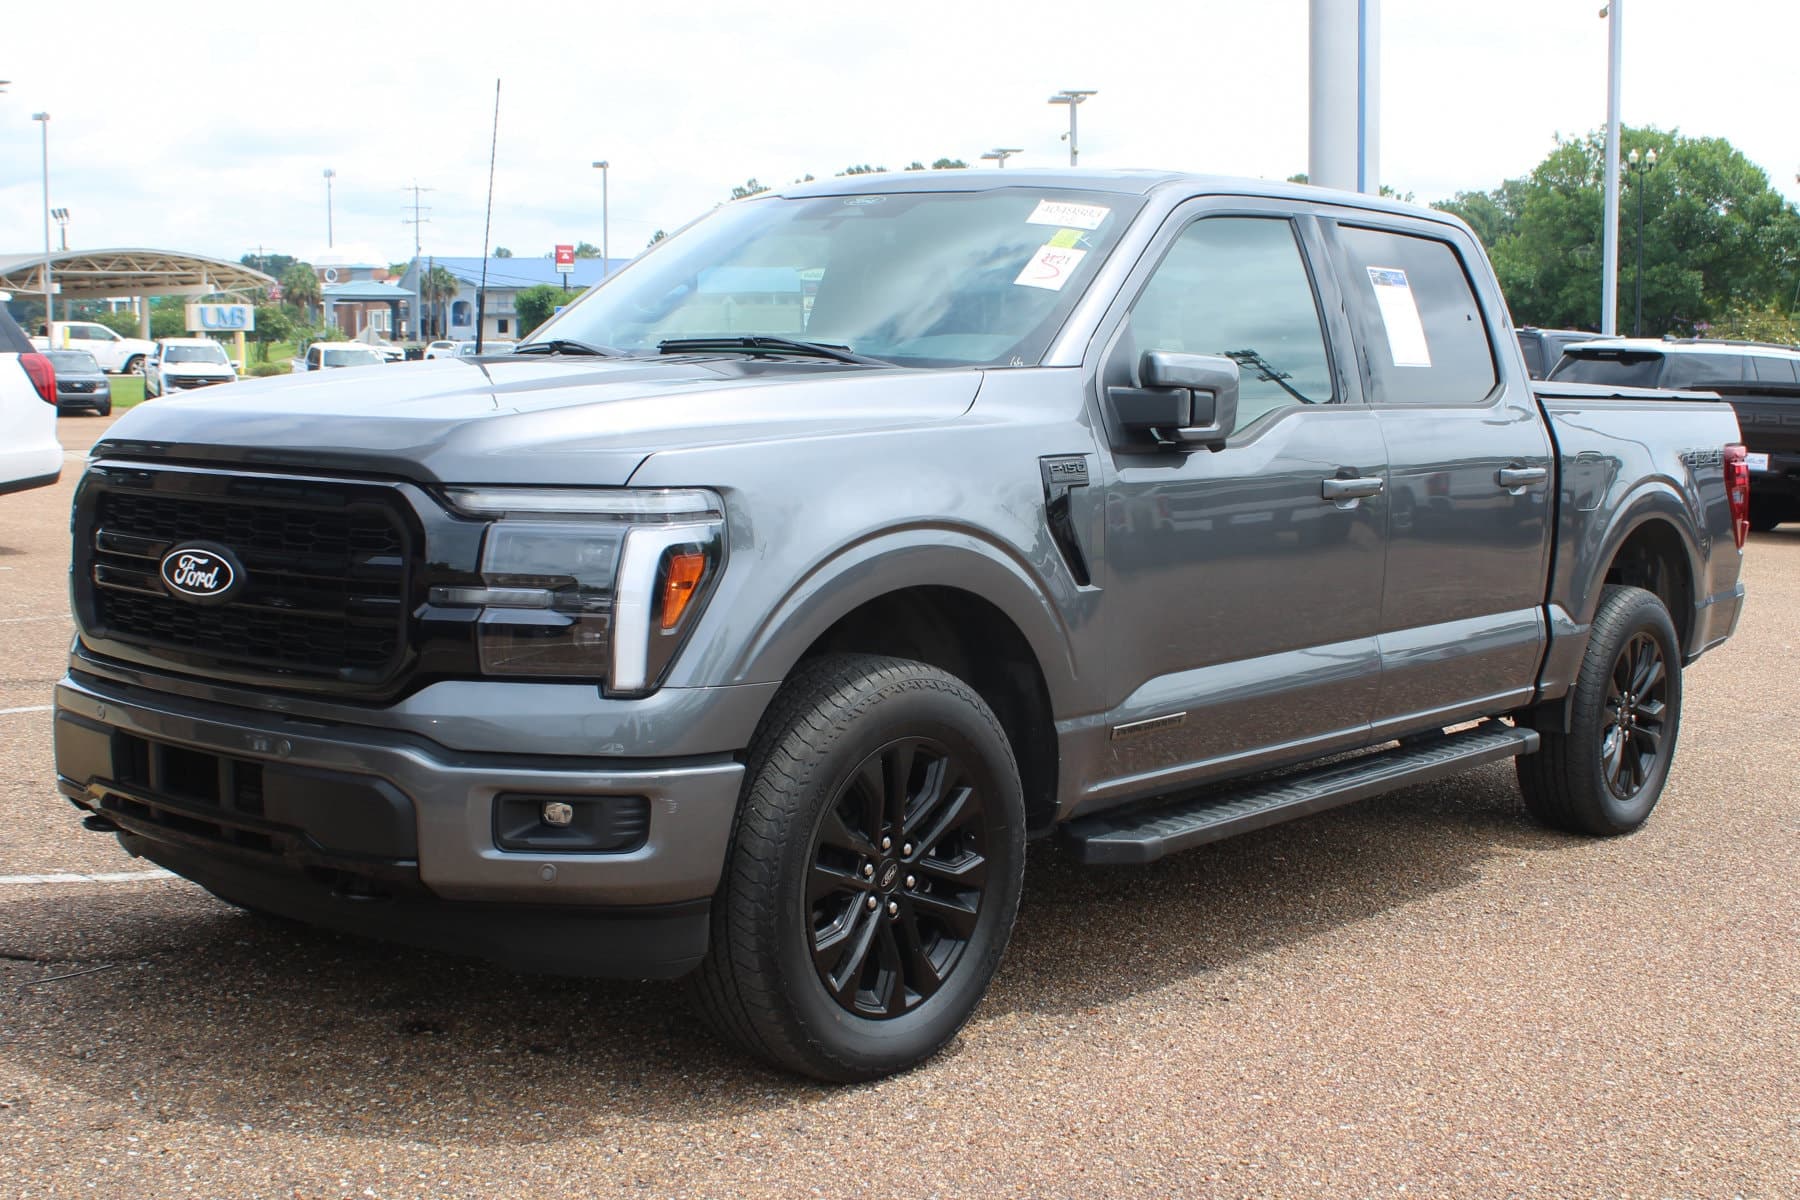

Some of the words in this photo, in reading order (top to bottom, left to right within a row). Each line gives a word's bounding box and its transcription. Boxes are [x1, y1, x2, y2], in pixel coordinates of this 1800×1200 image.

[199, 306, 246, 329] UMB
[1049, 462, 1086, 474] F-150
[175, 555, 219, 589] Ford
